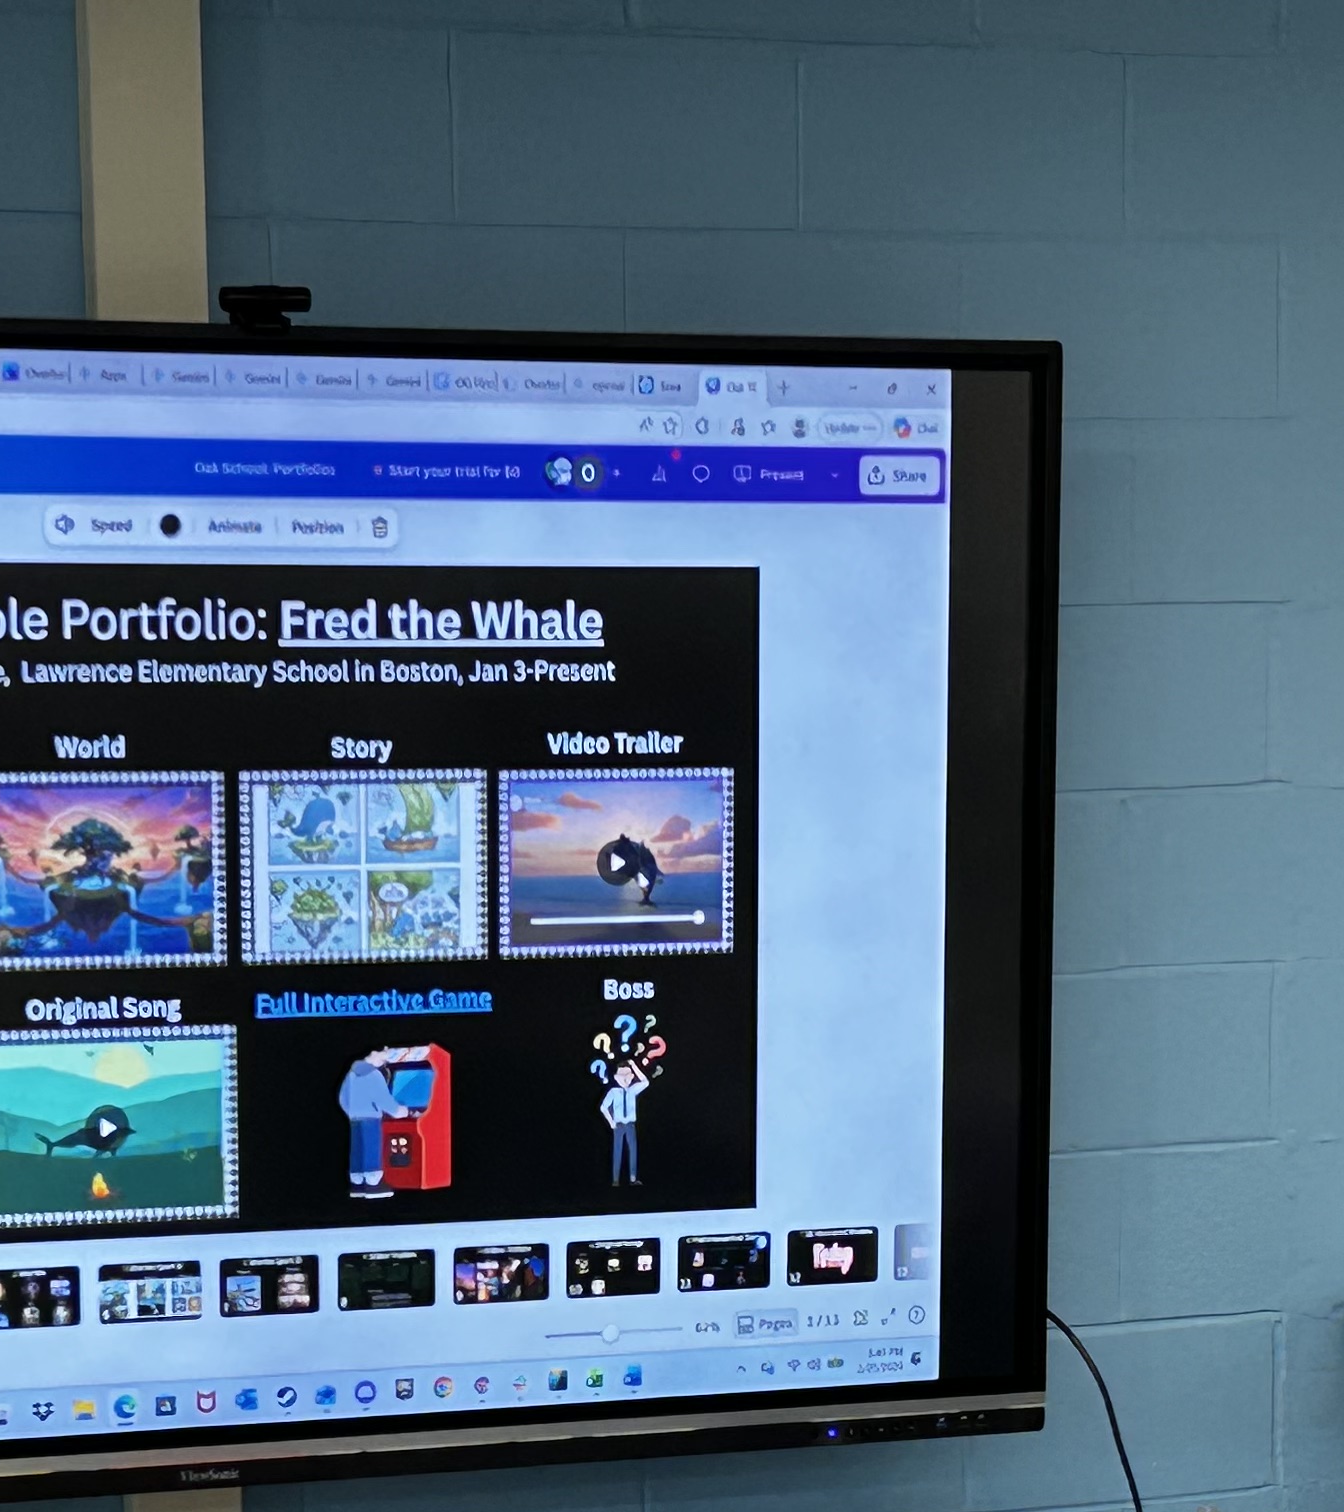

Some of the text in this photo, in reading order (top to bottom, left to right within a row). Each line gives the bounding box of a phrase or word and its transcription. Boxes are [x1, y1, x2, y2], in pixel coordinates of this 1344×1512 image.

[90, 517, 134, 537] Speed
[62, 598, 268, 642] Portfolio:
[280, 599, 377, 641] Fred
[388, 600, 462, 641] the
[472, 599, 604, 641] Whale
[21, 659, 133, 684] Lawrence
[138, 658, 267, 688] Elementary
[272, 660, 350, 684] School
[354, 659, 374, 683] in
[380, 660, 464, 687] Boston,
[469, 660, 508, 683] Jan
[513, 659, 616, 683] 3-Present
[53, 734, 127, 760] World
[330, 736, 393, 764] Story
[547, 731, 684, 755] Video Trailer
[256, 988, 493, 1016] Full Interactive Game
[603, 978, 655, 1001] Boss
[25, 996, 183, 1025] Original Song
